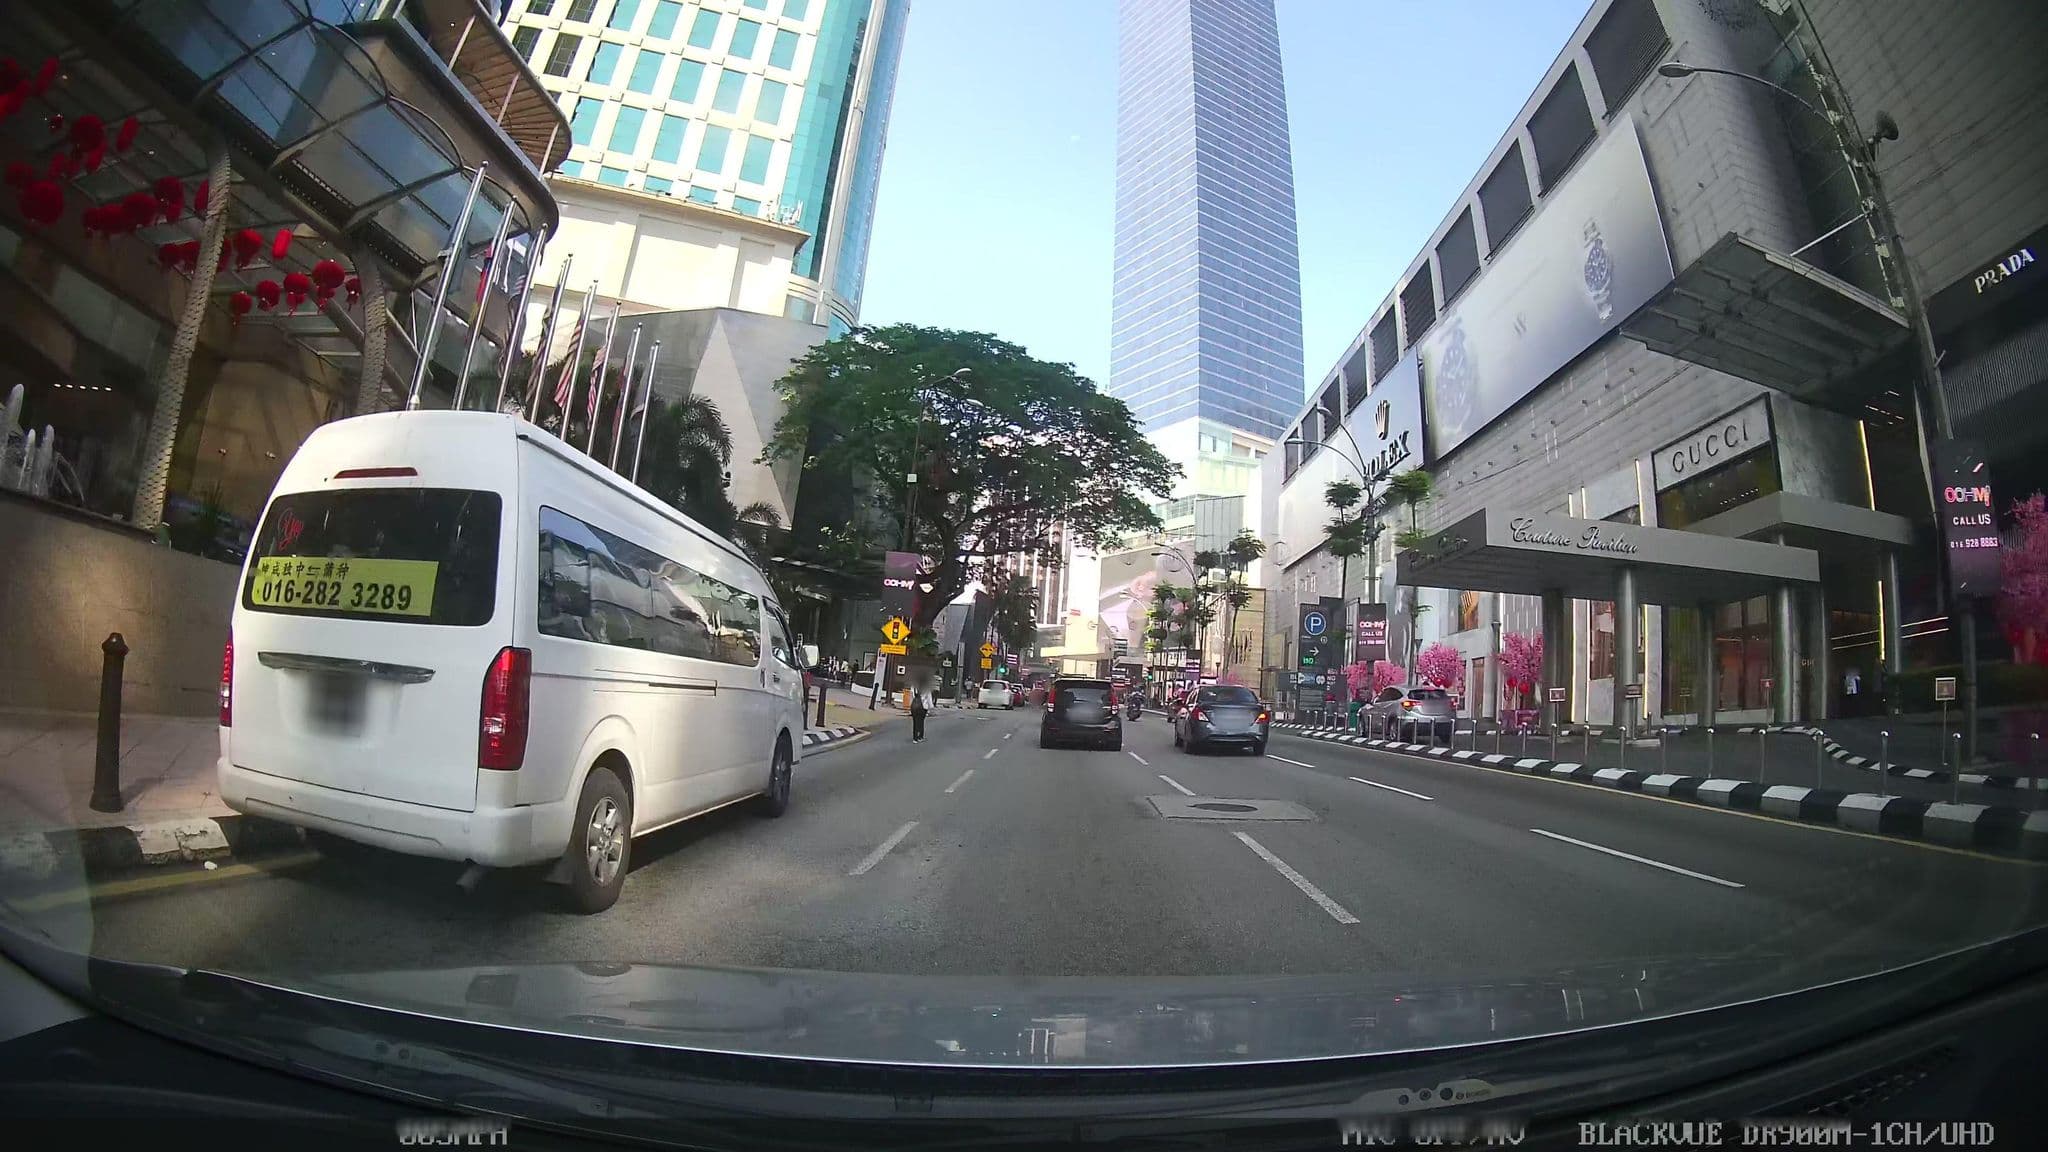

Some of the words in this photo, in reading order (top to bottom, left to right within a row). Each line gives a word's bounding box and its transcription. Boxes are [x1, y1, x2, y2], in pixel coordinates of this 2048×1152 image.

[1974, 248, 2034, 294] PRADA
[1672, 418, 1749, 473] GUCCI
[1510, 517, 1571, 547] Couture
[1576, 525, 1639, 554] Pavilion
[1952, 515, 1977, 526] CALL
[1978, 513, 1992, 525] US
[262, 579, 341, 606] 016-282
[350, 582, 412, 611] 3289
[1310, 616, 1322, 632] P
